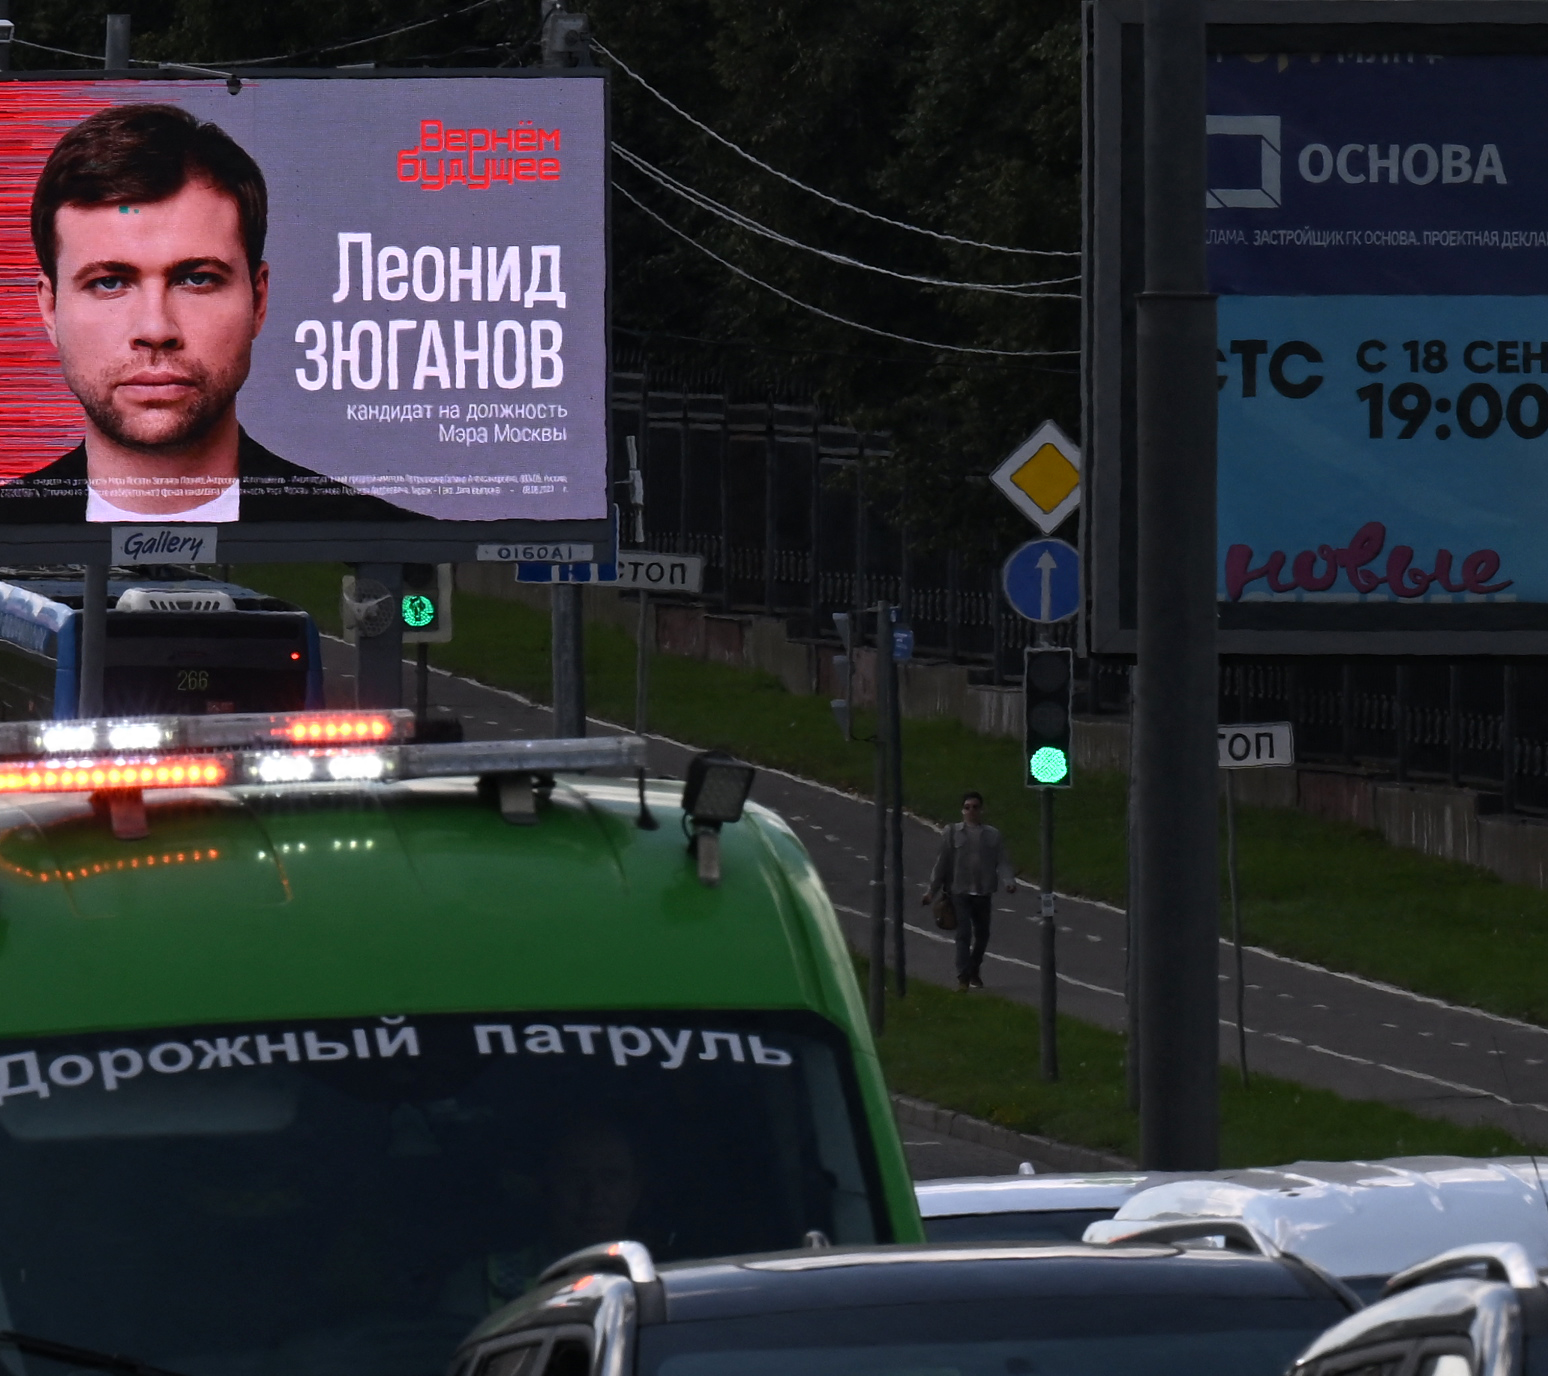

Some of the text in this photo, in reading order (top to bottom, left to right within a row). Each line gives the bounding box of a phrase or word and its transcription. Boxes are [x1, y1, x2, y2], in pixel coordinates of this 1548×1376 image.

[420, 120, 561, 152] Вернём
[397, 146, 561, 191] будущее
[1298, 143, 1506, 186] ОСНОВА
[1253, 226, 1343, 248] ЗАСТРОЙЩИК
[1346, 230, 1361, 245] ГК
[1364, 231, 1420, 246] ОСНОВА.
[1423, 231, 1499, 246] ПРОЕКТНАЯ
[332, 232, 566, 309] Леонид
[295, 319, 564, 391] ЗЮГАНОВ
[1356, 339, 1387, 373] С
[1402, 340, 1448, 374] 18
[347, 403, 567, 423] кандидат на должность
[439, 424, 567, 446] Мэра Москвы
[124, 532, 205, 559] Gallery
[1225, 522, 1513, 601] новые
[177, 670, 209, 691] 266
[472, 1024, 796, 1070] патруль
